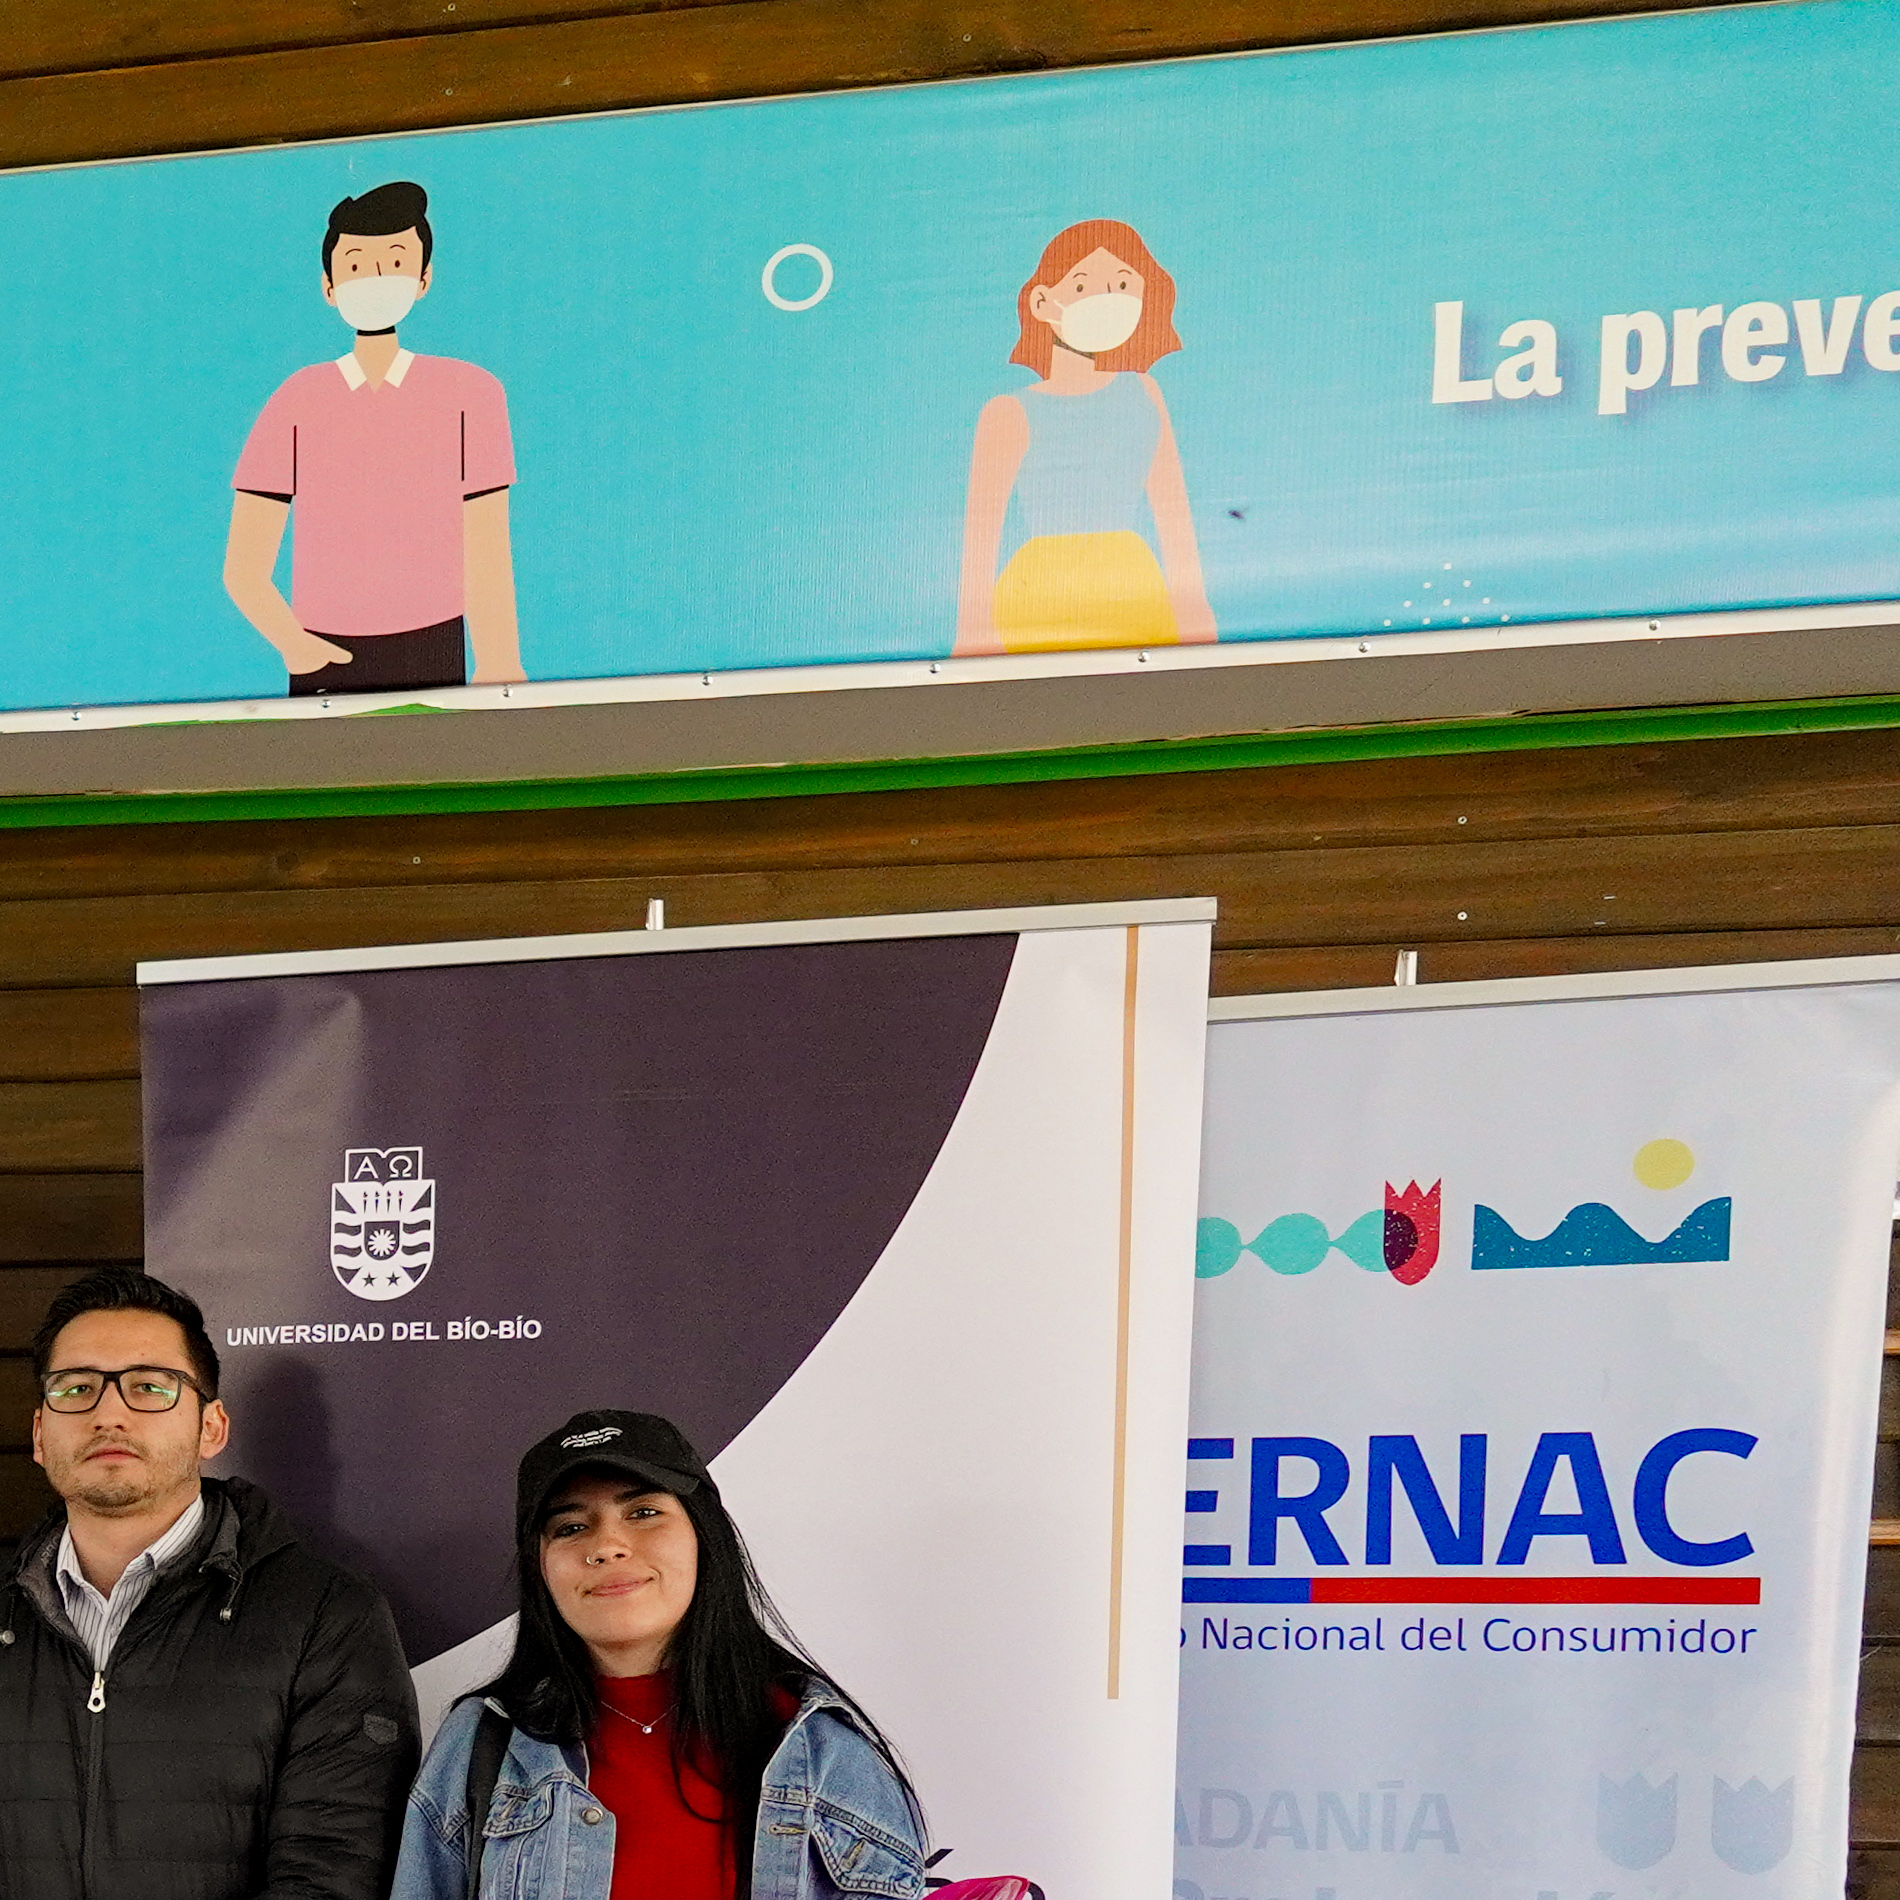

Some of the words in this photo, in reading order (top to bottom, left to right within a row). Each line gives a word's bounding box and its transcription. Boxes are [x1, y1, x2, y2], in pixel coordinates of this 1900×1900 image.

[1431, 300, 1563, 404] La
[227, 1322, 384, 1347] UNIVERSIDAD
[392, 1322, 440, 1341] DEL
[447, 1315, 542, 1341] BÍO-BÍO
[1183, 1428, 1758, 1567] ERNAC
[1204, 1616, 1384, 1650] Nacional
[1401, 1617, 1466, 1651] del
[1483, 1618, 1757, 1653] Consumidor
